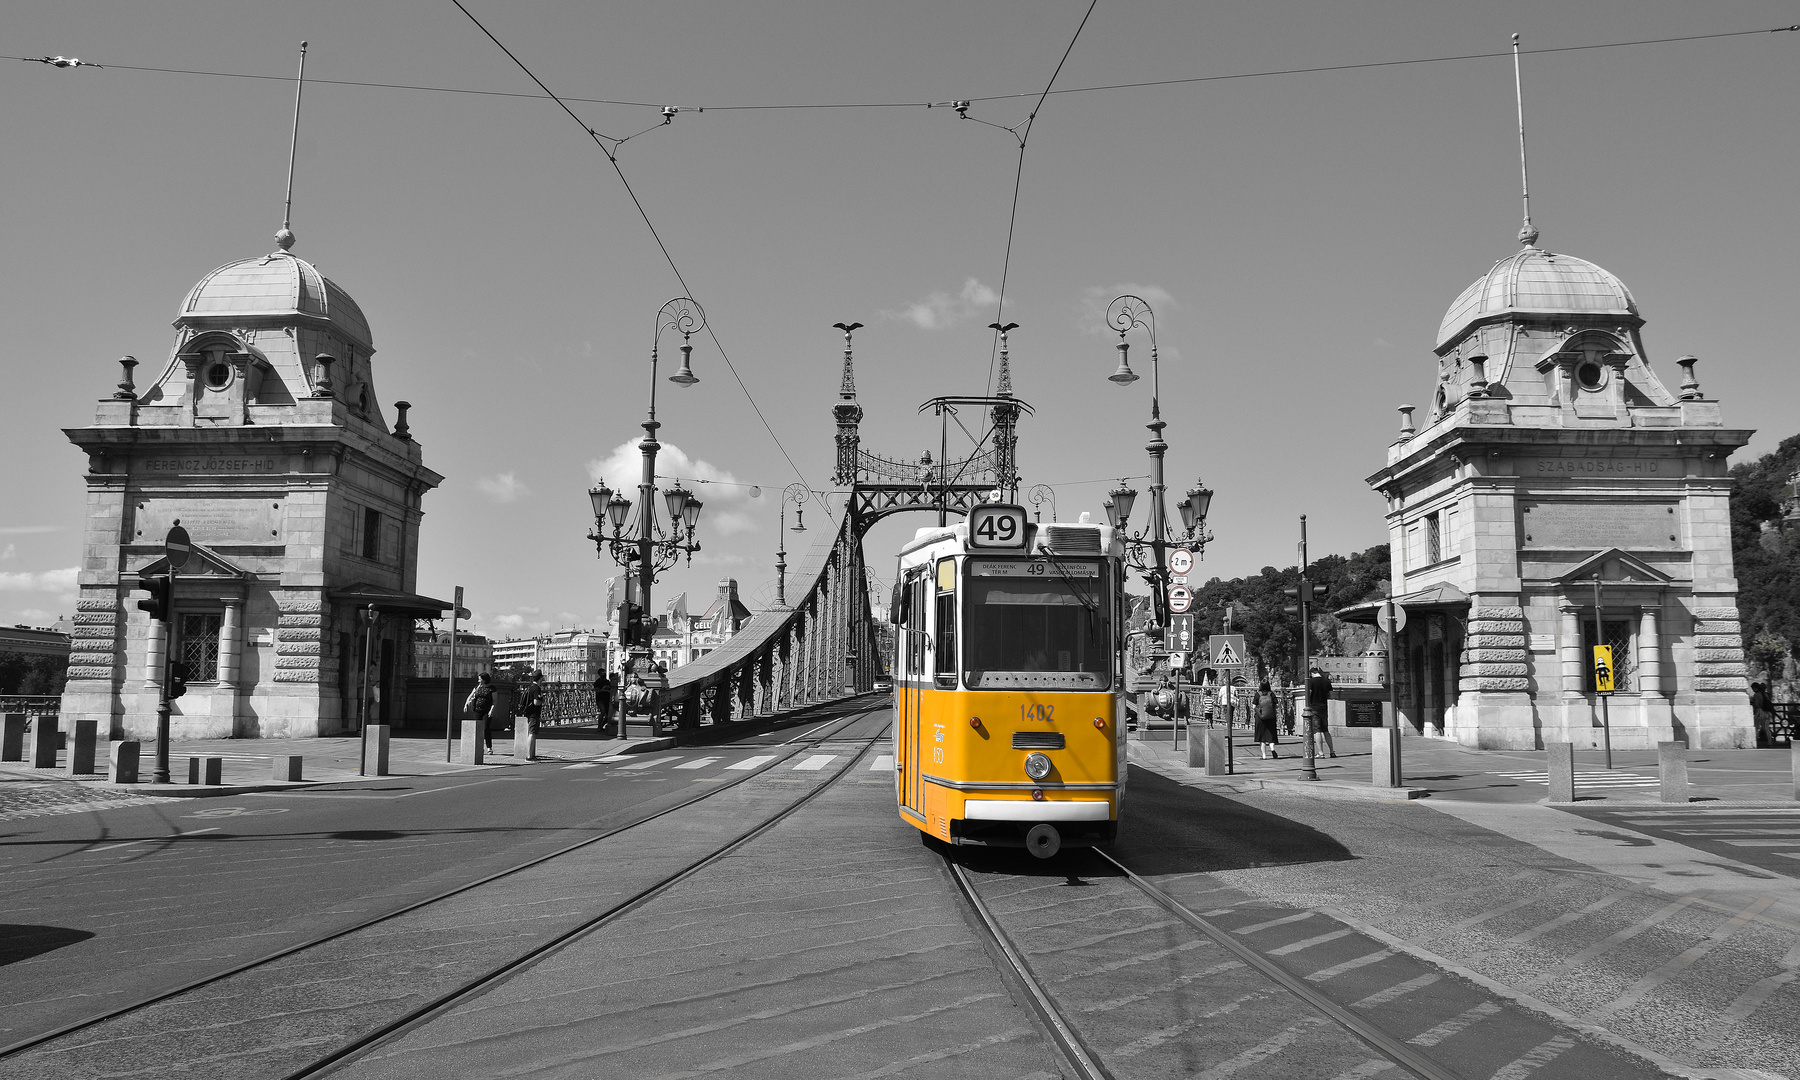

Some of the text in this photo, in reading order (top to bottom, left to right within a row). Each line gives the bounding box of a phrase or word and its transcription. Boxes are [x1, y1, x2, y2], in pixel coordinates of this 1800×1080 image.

[145, 460, 200, 470] FERENCZ
[976, 516, 1017, 540] 49
[1175, 557, 1179, 566] 2
[1026, 564, 1045, 575] 49
[1020, 704, 1054, 721] 1402
